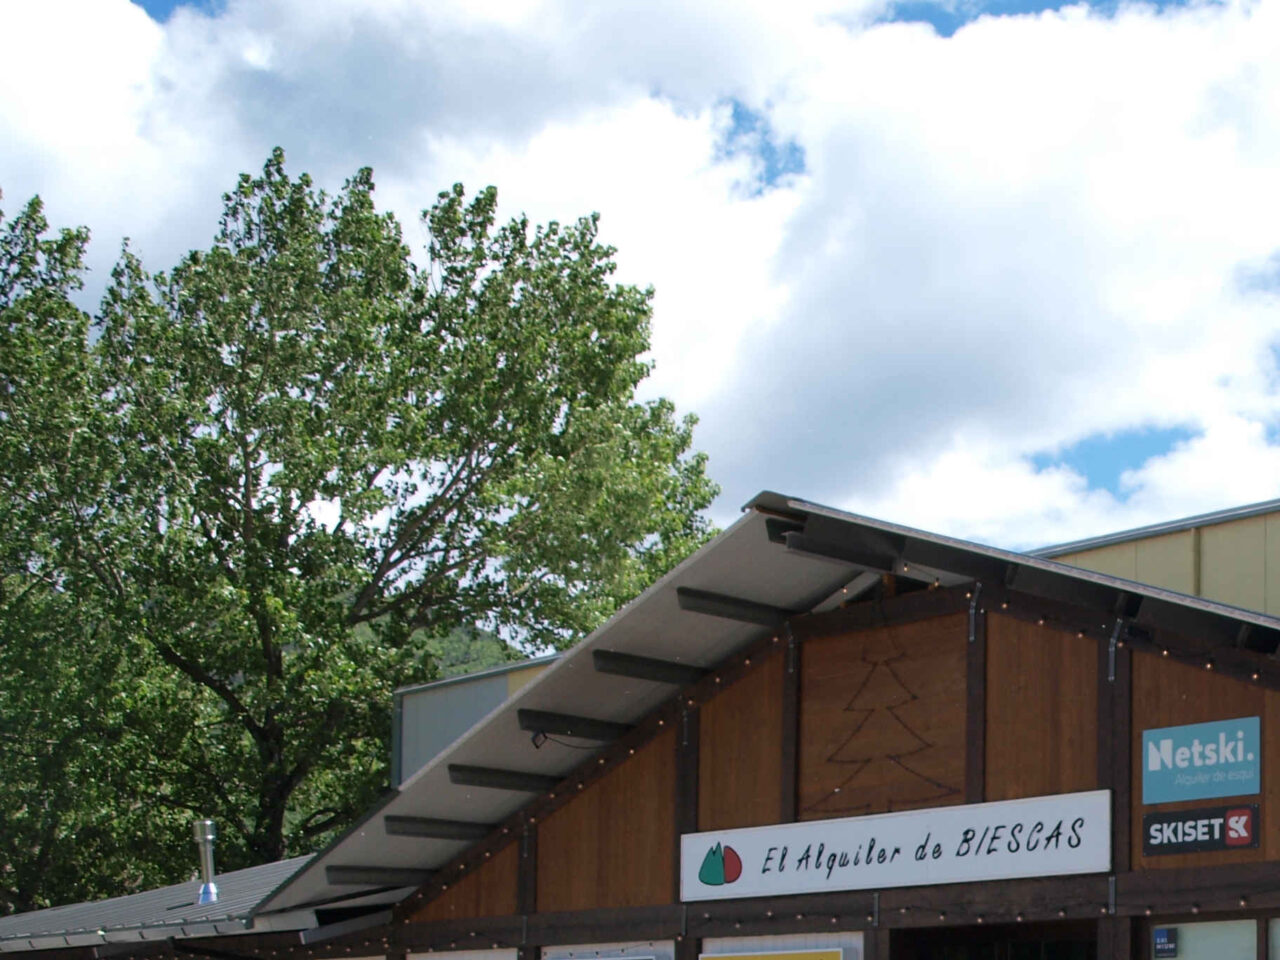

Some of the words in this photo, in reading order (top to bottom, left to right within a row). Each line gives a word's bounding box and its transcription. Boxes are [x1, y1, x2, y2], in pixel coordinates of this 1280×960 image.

[762, 846, 785, 874] El
[796, 838, 901, 880] Alquiler
[915, 832, 942, 861] de
[956, 818, 1084, 857] BIESCAS
[1149, 818, 1224, 845] SKISET
